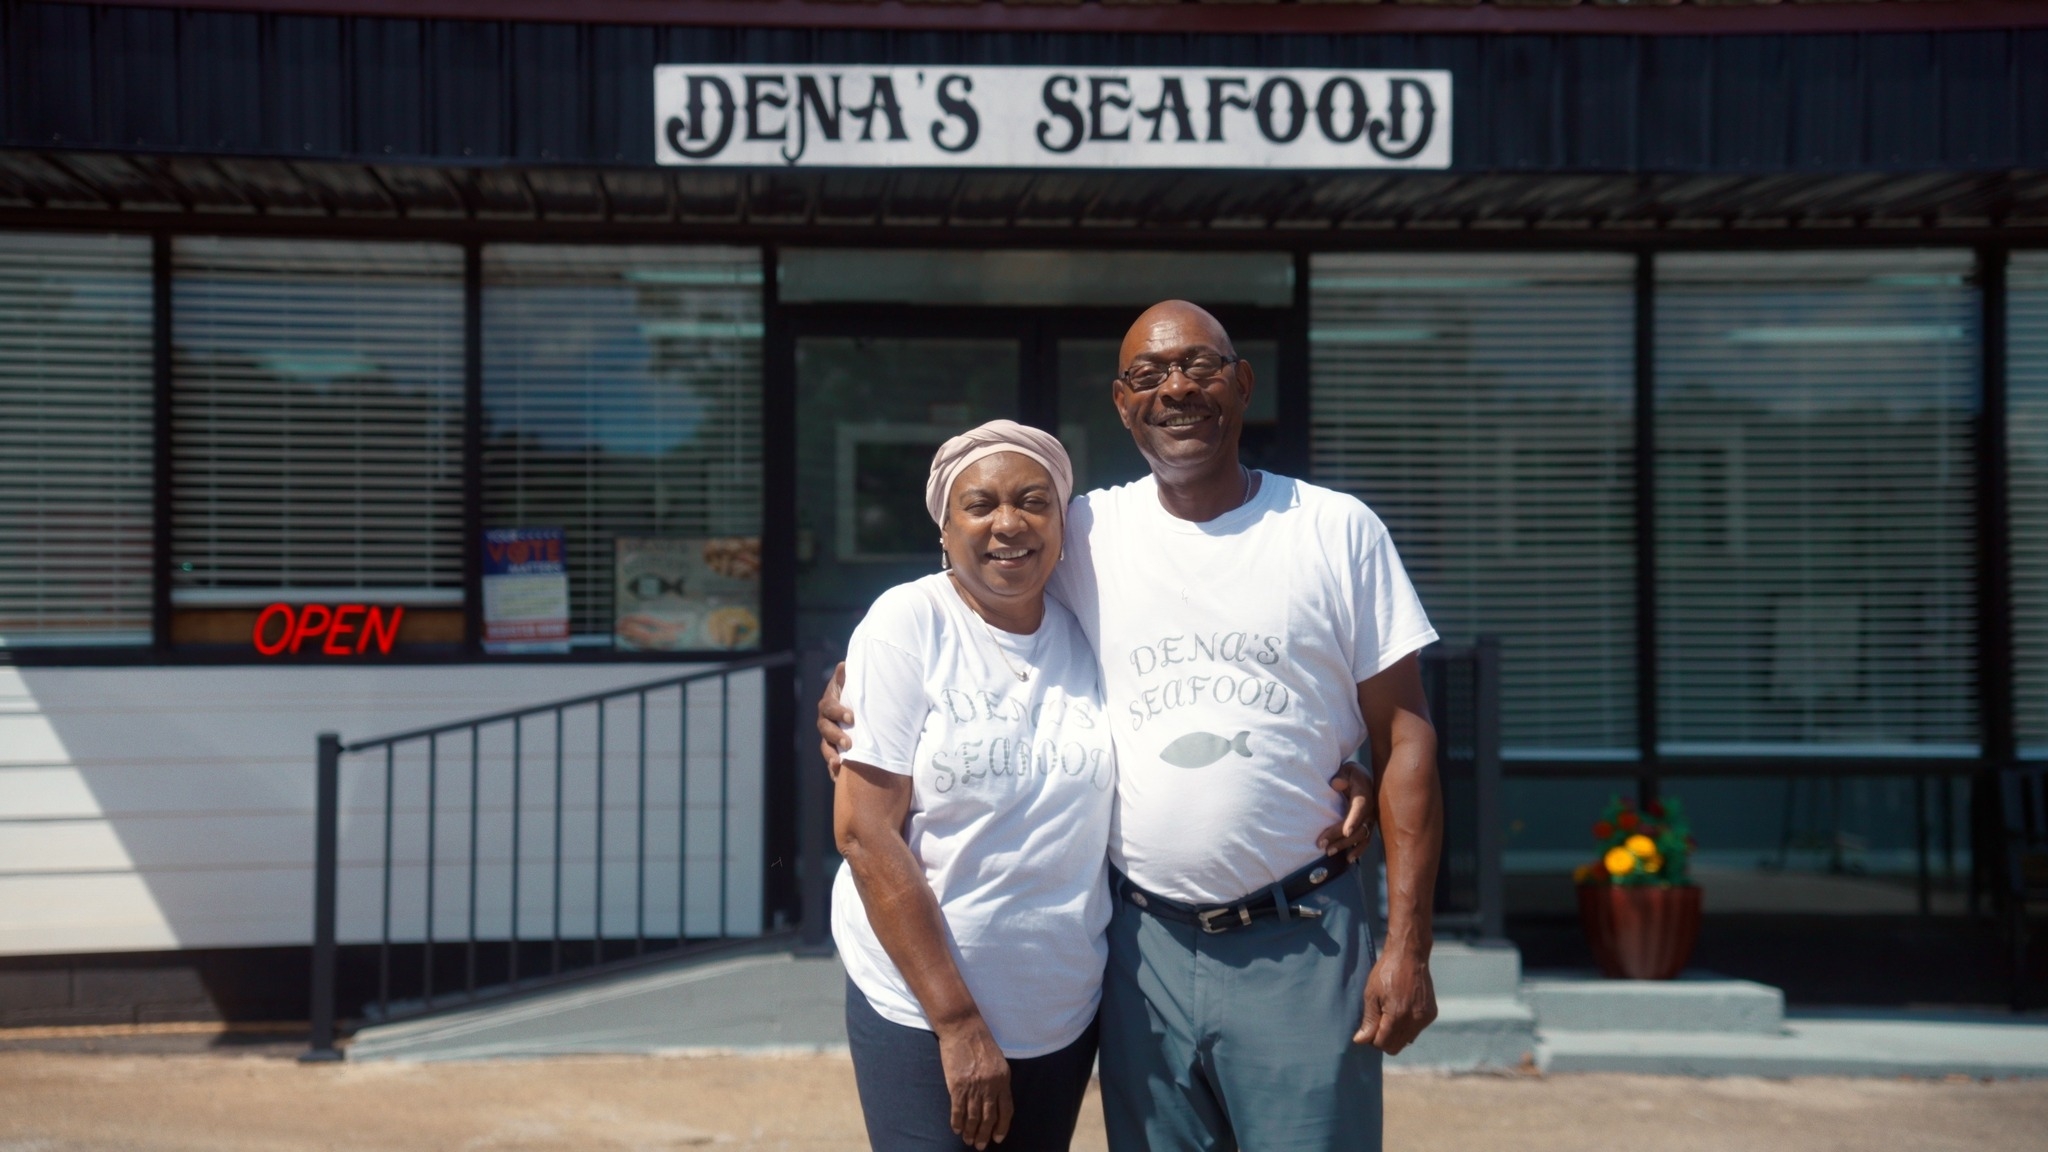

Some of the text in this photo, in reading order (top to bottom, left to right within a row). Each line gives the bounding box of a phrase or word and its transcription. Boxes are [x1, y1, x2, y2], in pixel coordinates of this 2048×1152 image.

[666, 72, 1436, 164] DENA'S SEAFOOD
[487, 538, 560, 565] VOTE
[253, 602, 404, 656] OPEN
[1129, 632, 1282, 677] DENA'S
[1129, 675, 1289, 731] SEAFOOD
